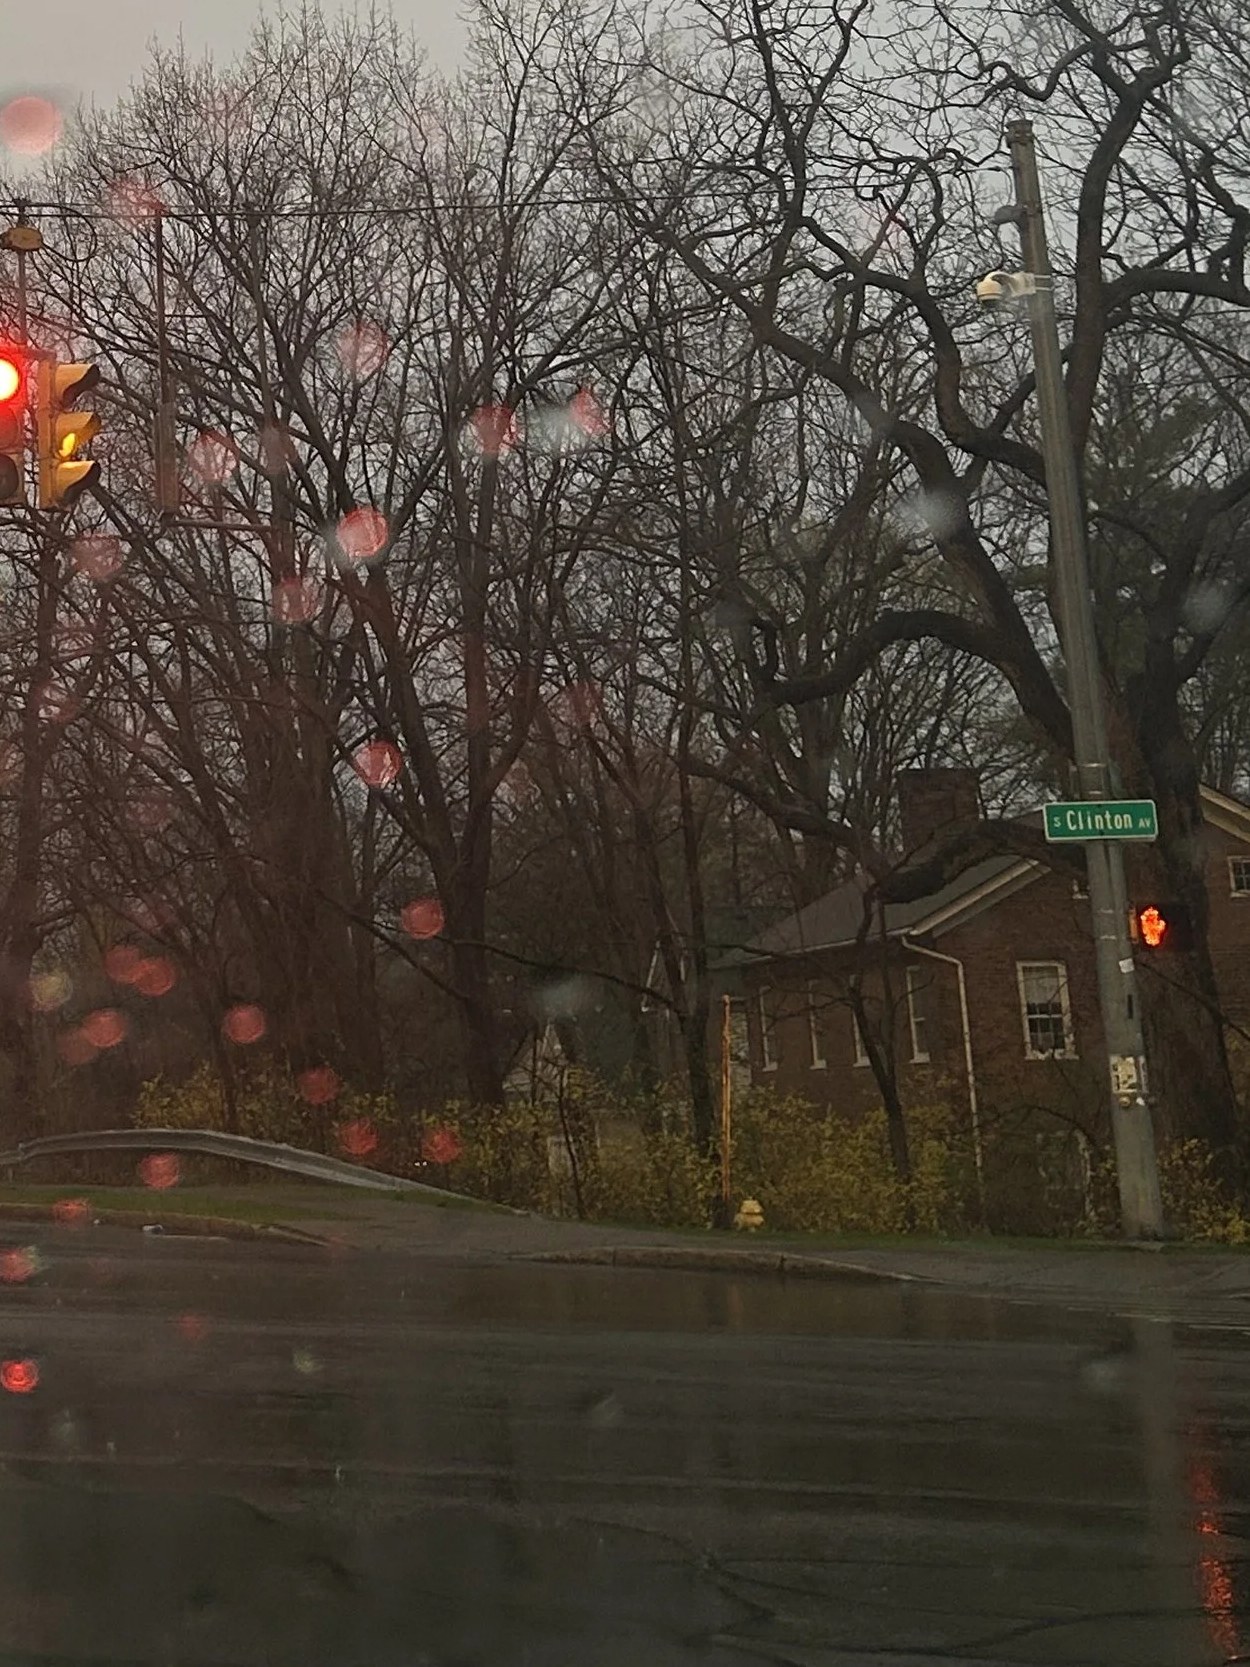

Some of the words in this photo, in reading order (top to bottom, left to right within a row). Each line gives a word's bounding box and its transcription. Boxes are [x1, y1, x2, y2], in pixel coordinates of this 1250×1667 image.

[1053, 816, 1062, 828] S
[1066, 810, 1134, 831] Clinton
[1138, 818, 1151, 829] AV
